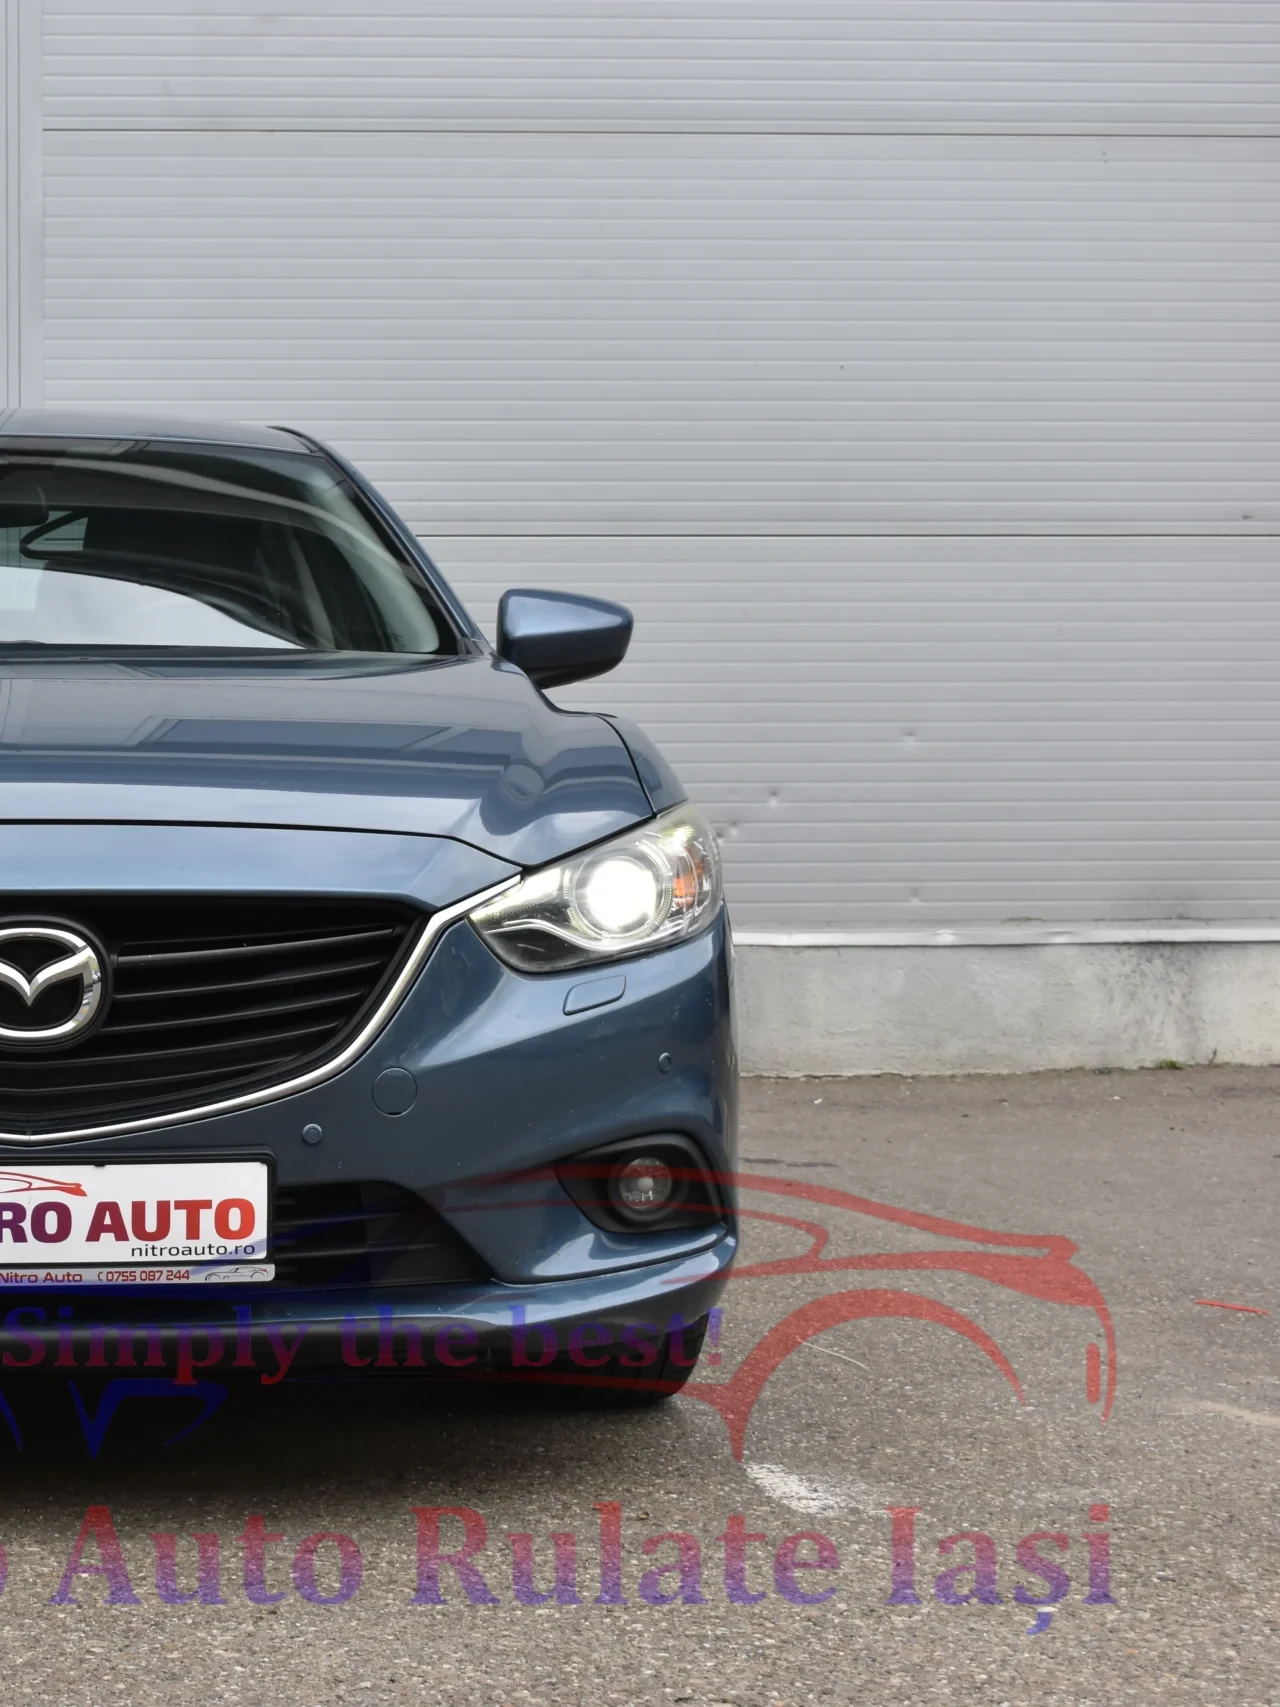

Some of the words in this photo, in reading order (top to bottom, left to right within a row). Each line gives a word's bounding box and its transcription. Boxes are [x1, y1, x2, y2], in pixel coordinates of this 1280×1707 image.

[85, 1198, 256, 1243] AUTO
[131, 1243, 256, 1257] nitroauto.ro
[43, 1272, 83, 1283] Auto
[106, 1270, 136, 1282] 0755
[140, 1270, 163, 1281] 087
[166, 1269, 190, 1281] 244
